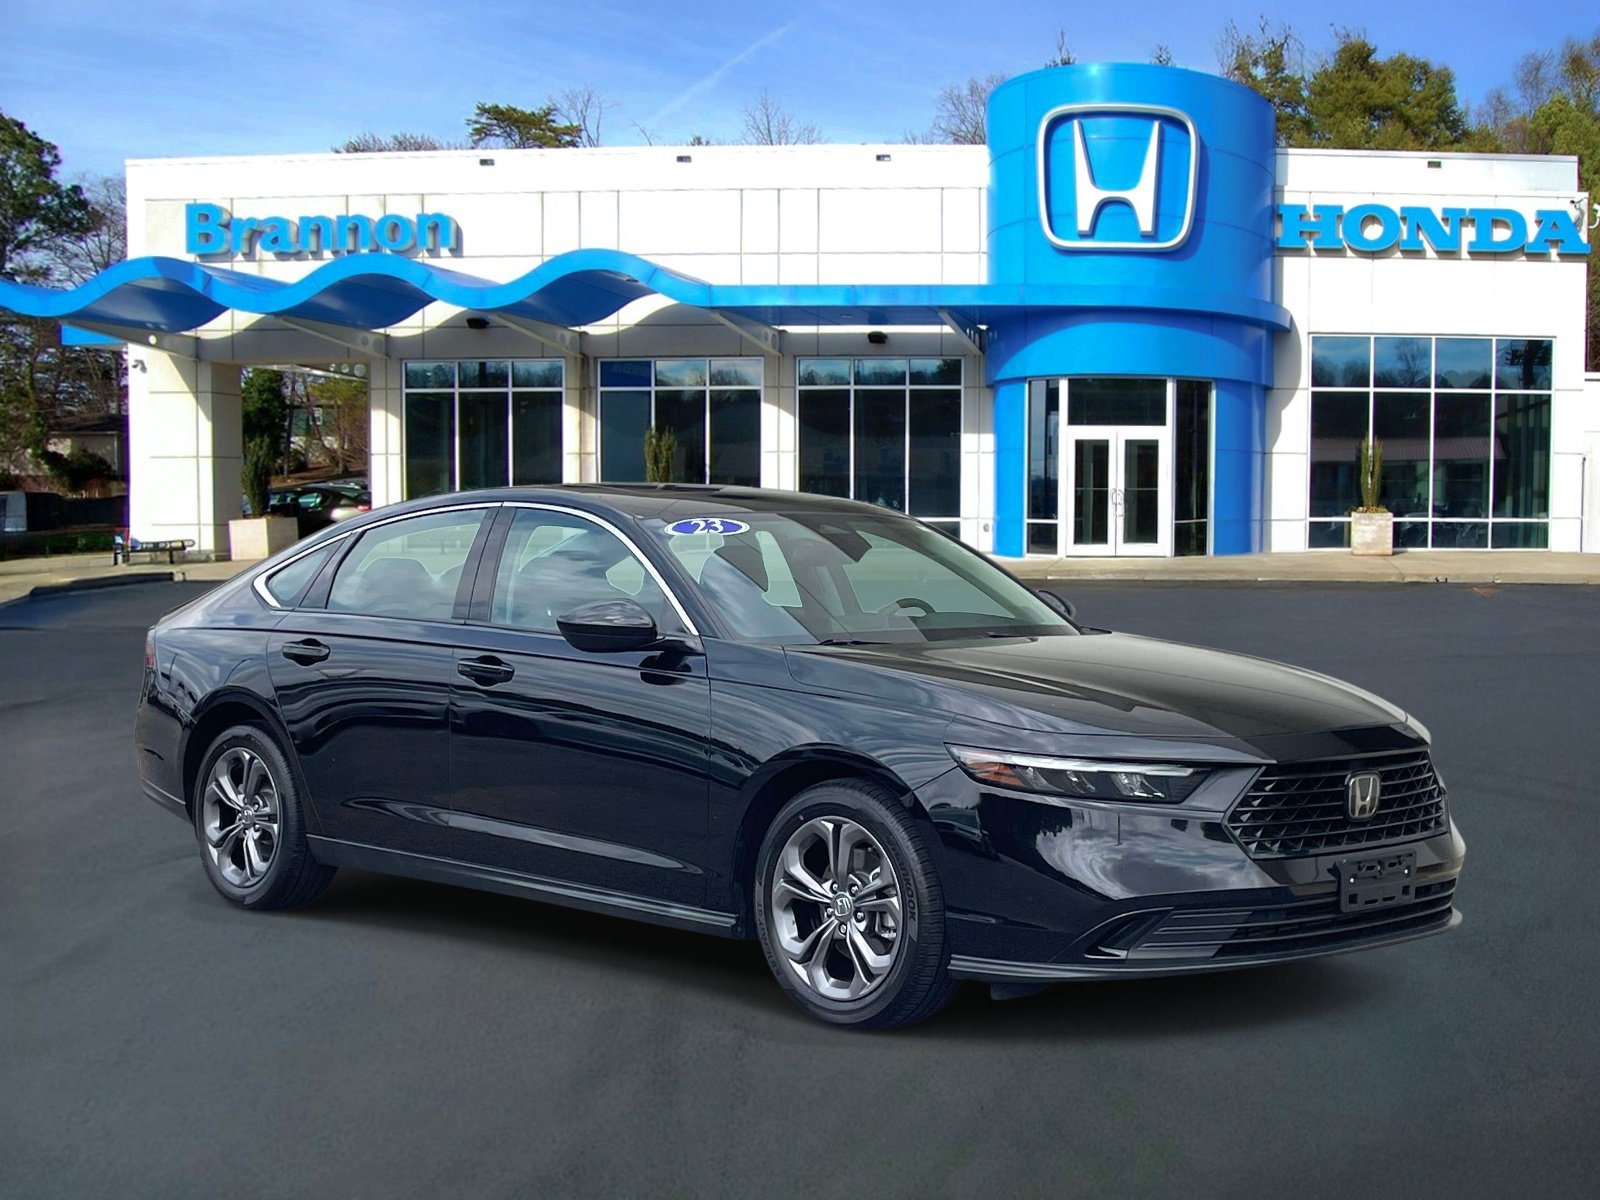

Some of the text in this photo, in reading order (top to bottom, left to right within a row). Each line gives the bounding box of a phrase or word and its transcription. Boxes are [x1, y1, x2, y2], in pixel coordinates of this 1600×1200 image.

[185, 202, 460, 257] Brannon
[1276, 203, 1592, 254] HONDA
[690, 519, 724, 534] 23
